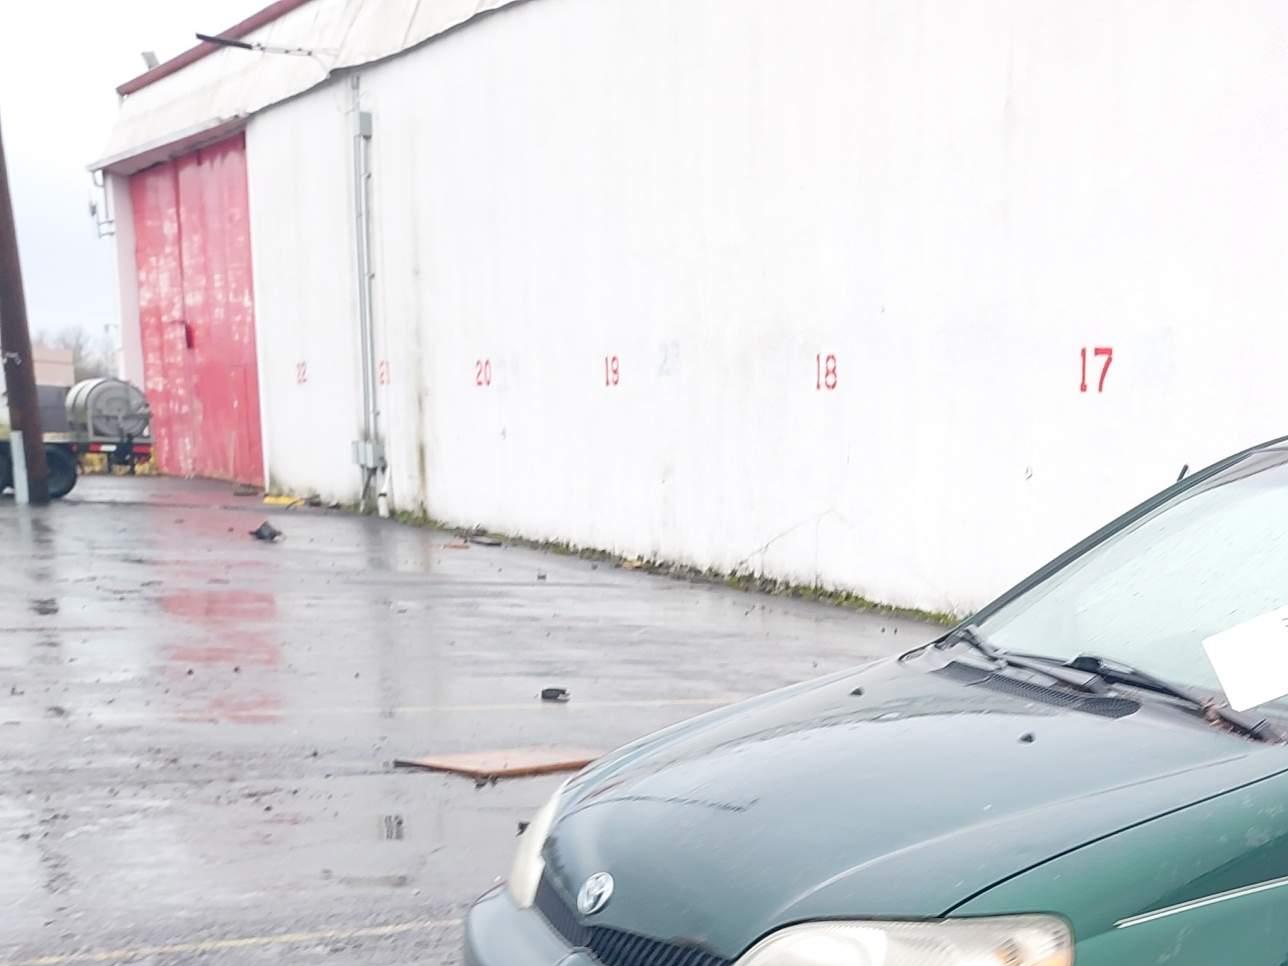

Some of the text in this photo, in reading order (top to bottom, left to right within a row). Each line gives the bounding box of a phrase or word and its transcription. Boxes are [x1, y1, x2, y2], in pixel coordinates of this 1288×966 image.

[475, 359, 492, 386] 20
[604, 356, 620, 386] 19
[816, 354, 838, 390] 18
[1079, 347, 1113, 393] 17
